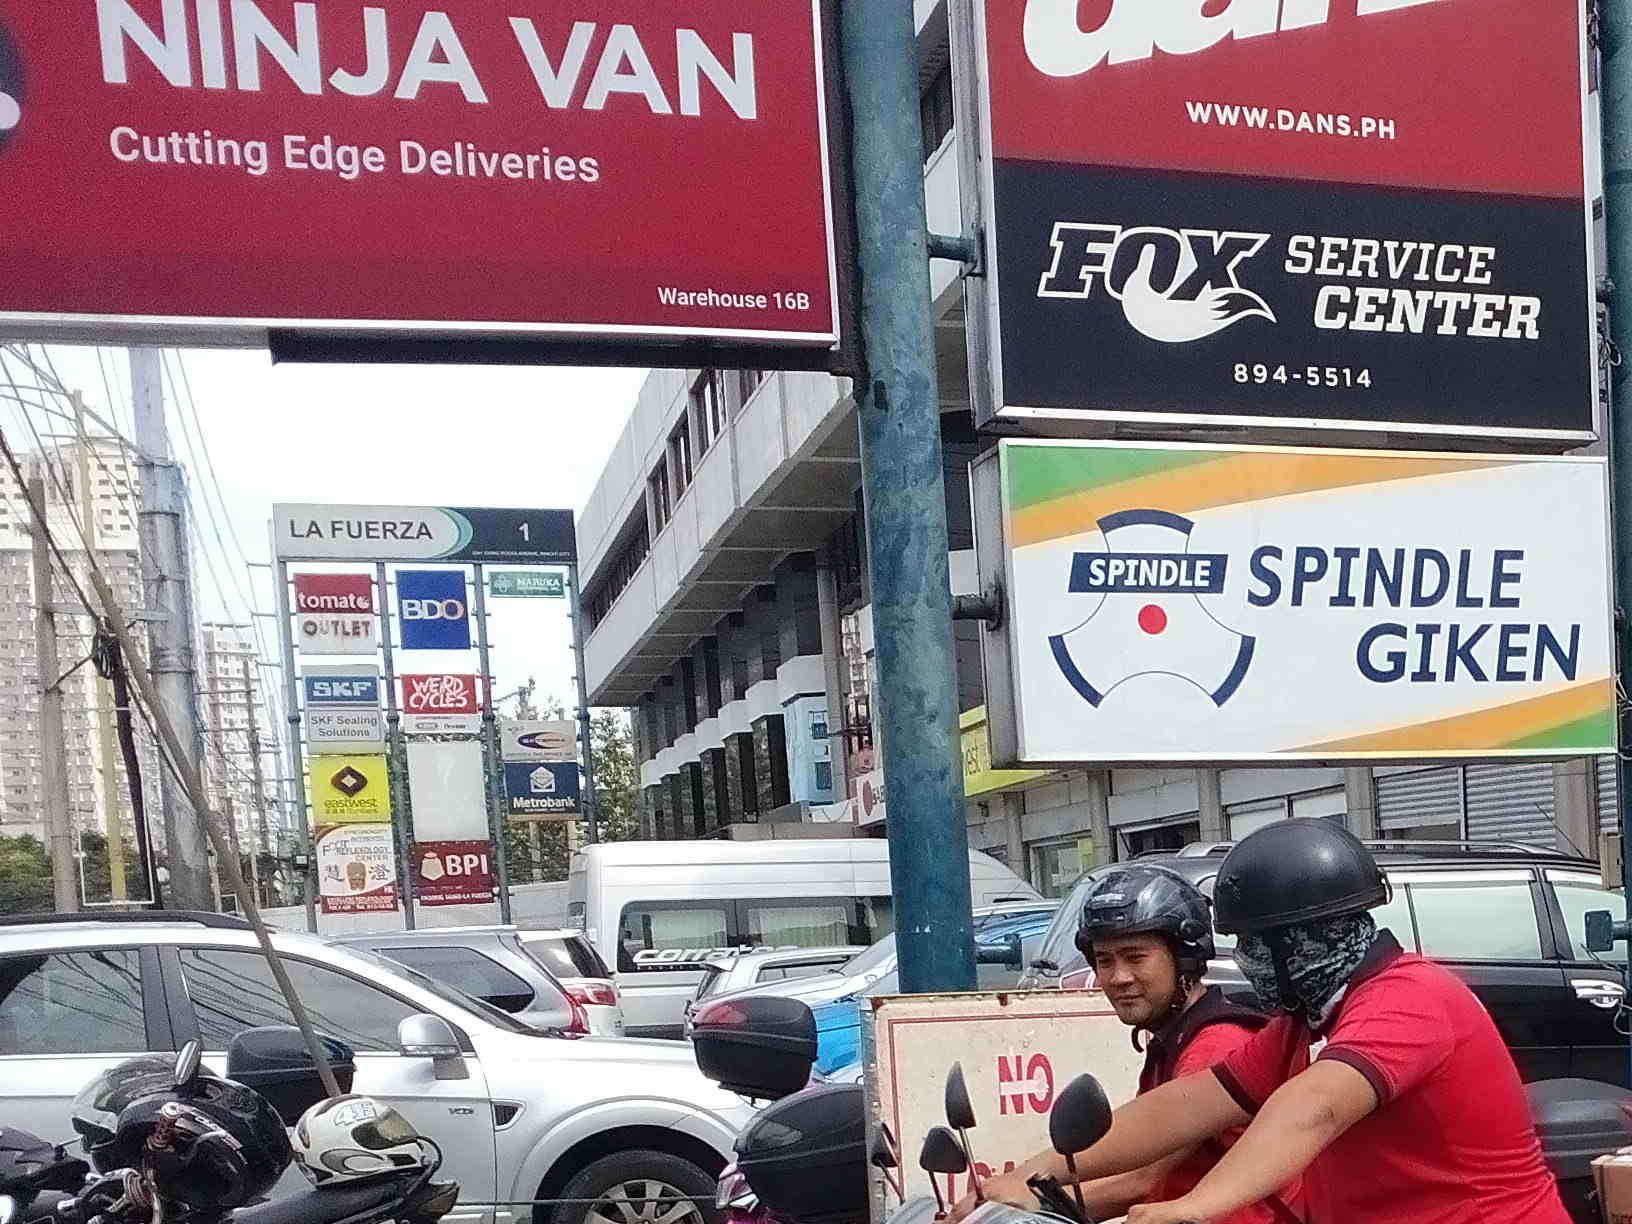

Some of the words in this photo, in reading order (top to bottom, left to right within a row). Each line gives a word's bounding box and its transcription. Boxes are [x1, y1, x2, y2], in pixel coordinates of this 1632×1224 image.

[95, 0, 488, 104] NINJA
[509, 14, 758, 120] VAN
[1186, 101, 1396, 140] WWW.DANS.PH
[110, 125, 269, 176] Cutting
[284, 135, 386, 177] Edge
[400, 140, 600, 184] Deliveries
[1036, 221, 1273, 320] FOX
[1283, 235, 1497, 285] SERVICE
[657, 285, 767, 310] Warehouse
[772, 290, 811, 311] 16B
[1313, 285, 1543, 341] CENTER
[1233, 362, 1372, 389] 894-5514
[290, 519, 323, 539] LA
[331, 520, 433, 540] FUERZA
[519, 523, 530, 542] 1
[1088, 557, 1212, 588] SPINDLE
[1246, 545, 1526, 610] SPINDLE
[402, 599, 465, 621] BDO
[303, 620, 371, 637] OUTLET
[1355, 621, 1582, 683] GIKEN
[312, 681, 372, 697] SKF
[408, 689, 469, 710] CYCLES
[311, 716, 333, 726] SKF
[337, 715, 378, 728] Sealing
[319, 728, 371, 738] Solutions
[513, 796, 576, 809] Metrobank
[445, 854, 489, 876] BPI
[998, 1052, 1055, 1116] NO
